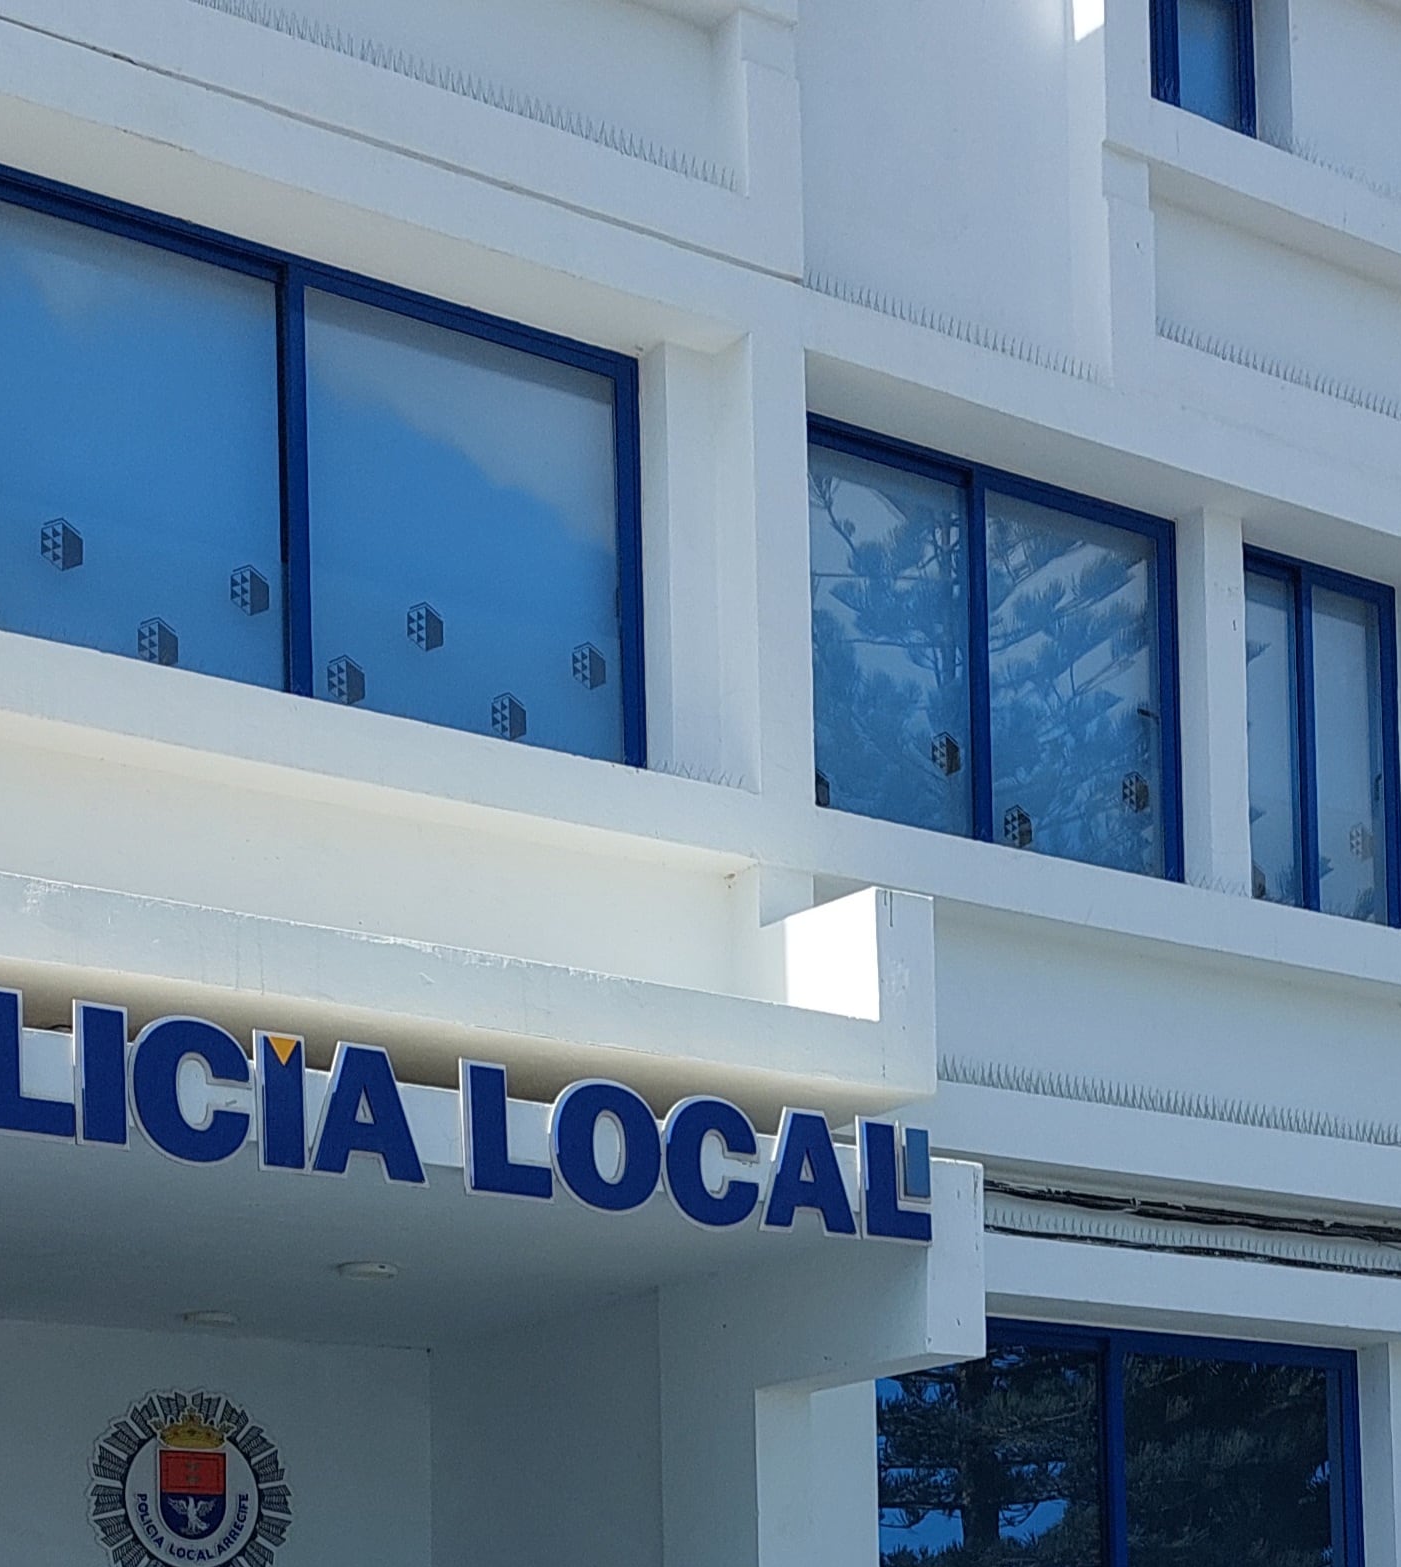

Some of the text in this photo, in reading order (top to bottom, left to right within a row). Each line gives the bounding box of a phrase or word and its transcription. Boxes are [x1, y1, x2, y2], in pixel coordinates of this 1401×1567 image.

[459, 1058, 933, 1246] LOCAL
[136, 1493, 250, 1561] POLICIA LOCAL ARRECIFE
